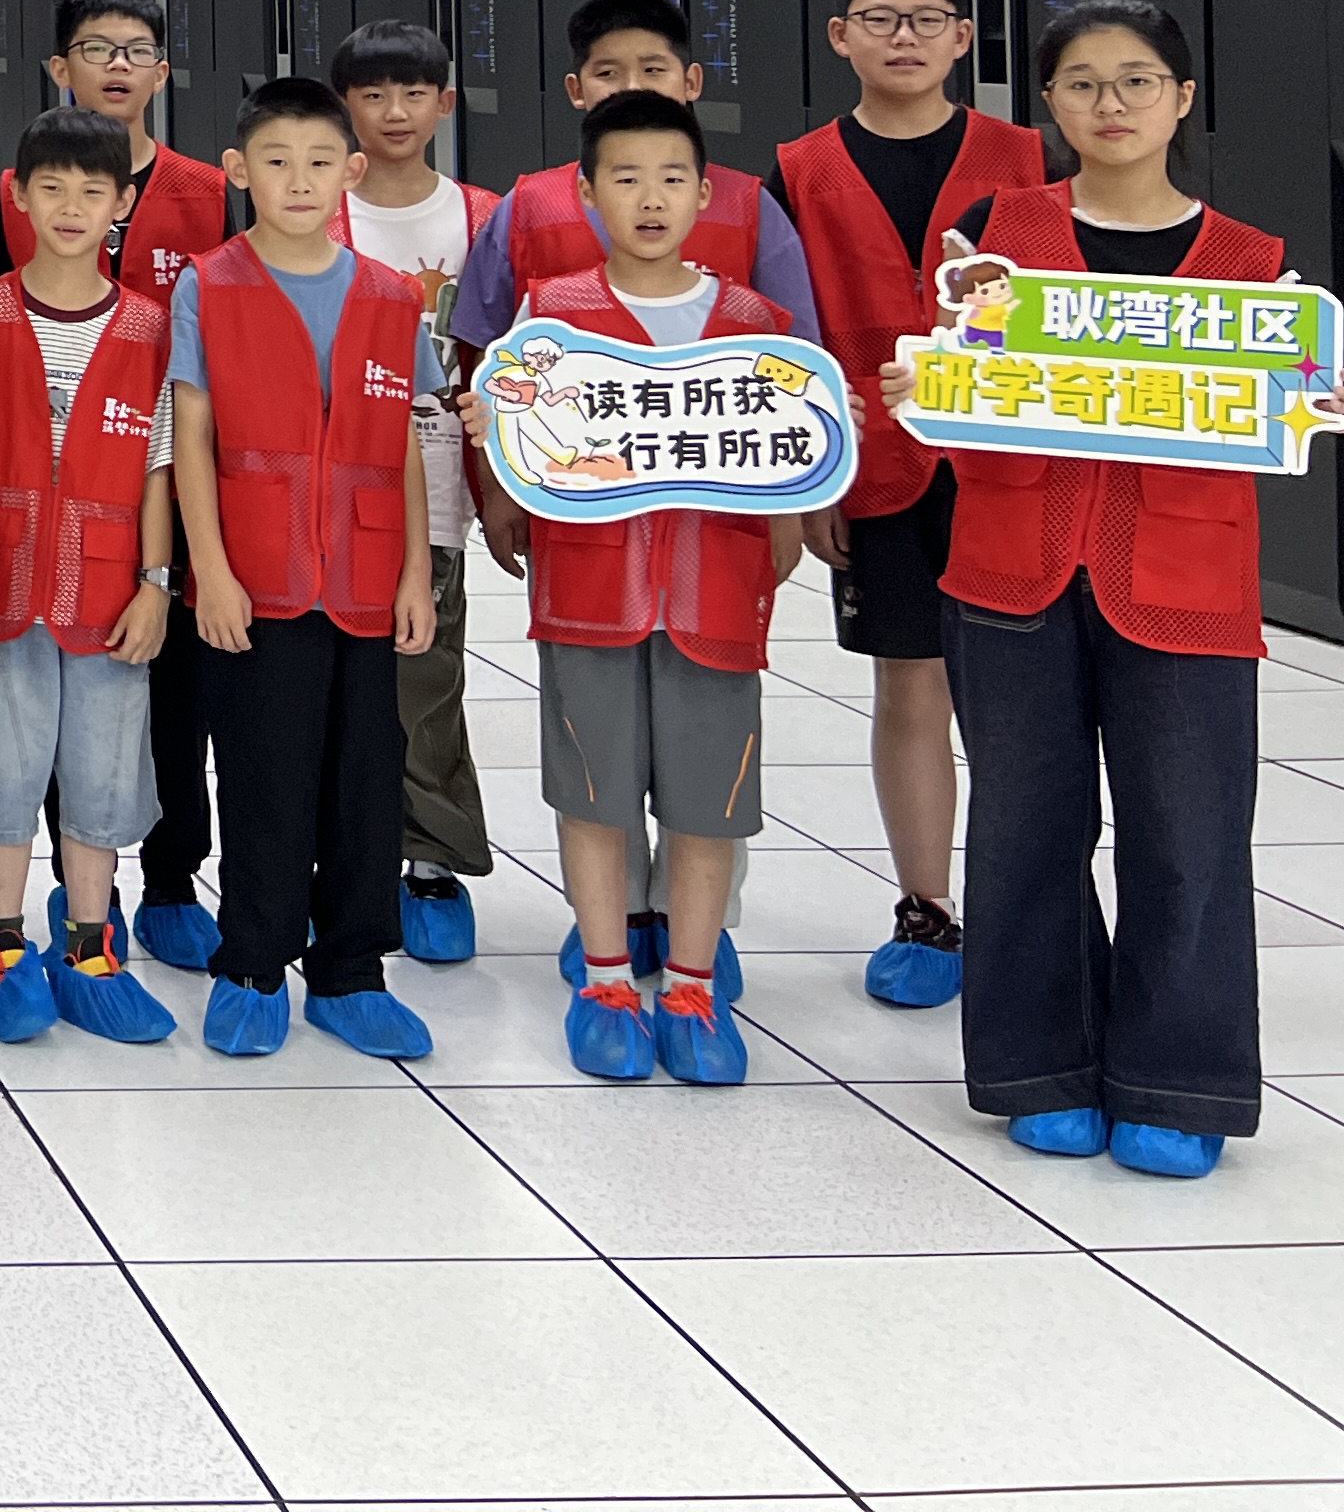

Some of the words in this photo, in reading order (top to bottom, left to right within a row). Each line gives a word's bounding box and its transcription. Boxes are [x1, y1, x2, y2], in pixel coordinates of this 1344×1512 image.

[1041, 286, 1301, 355] 耿湾社区
[583, 375, 777, 420] 读有所获
[912, 351, 1258, 438] 研学奇遇记
[618, 427, 814, 472] 行有所成
